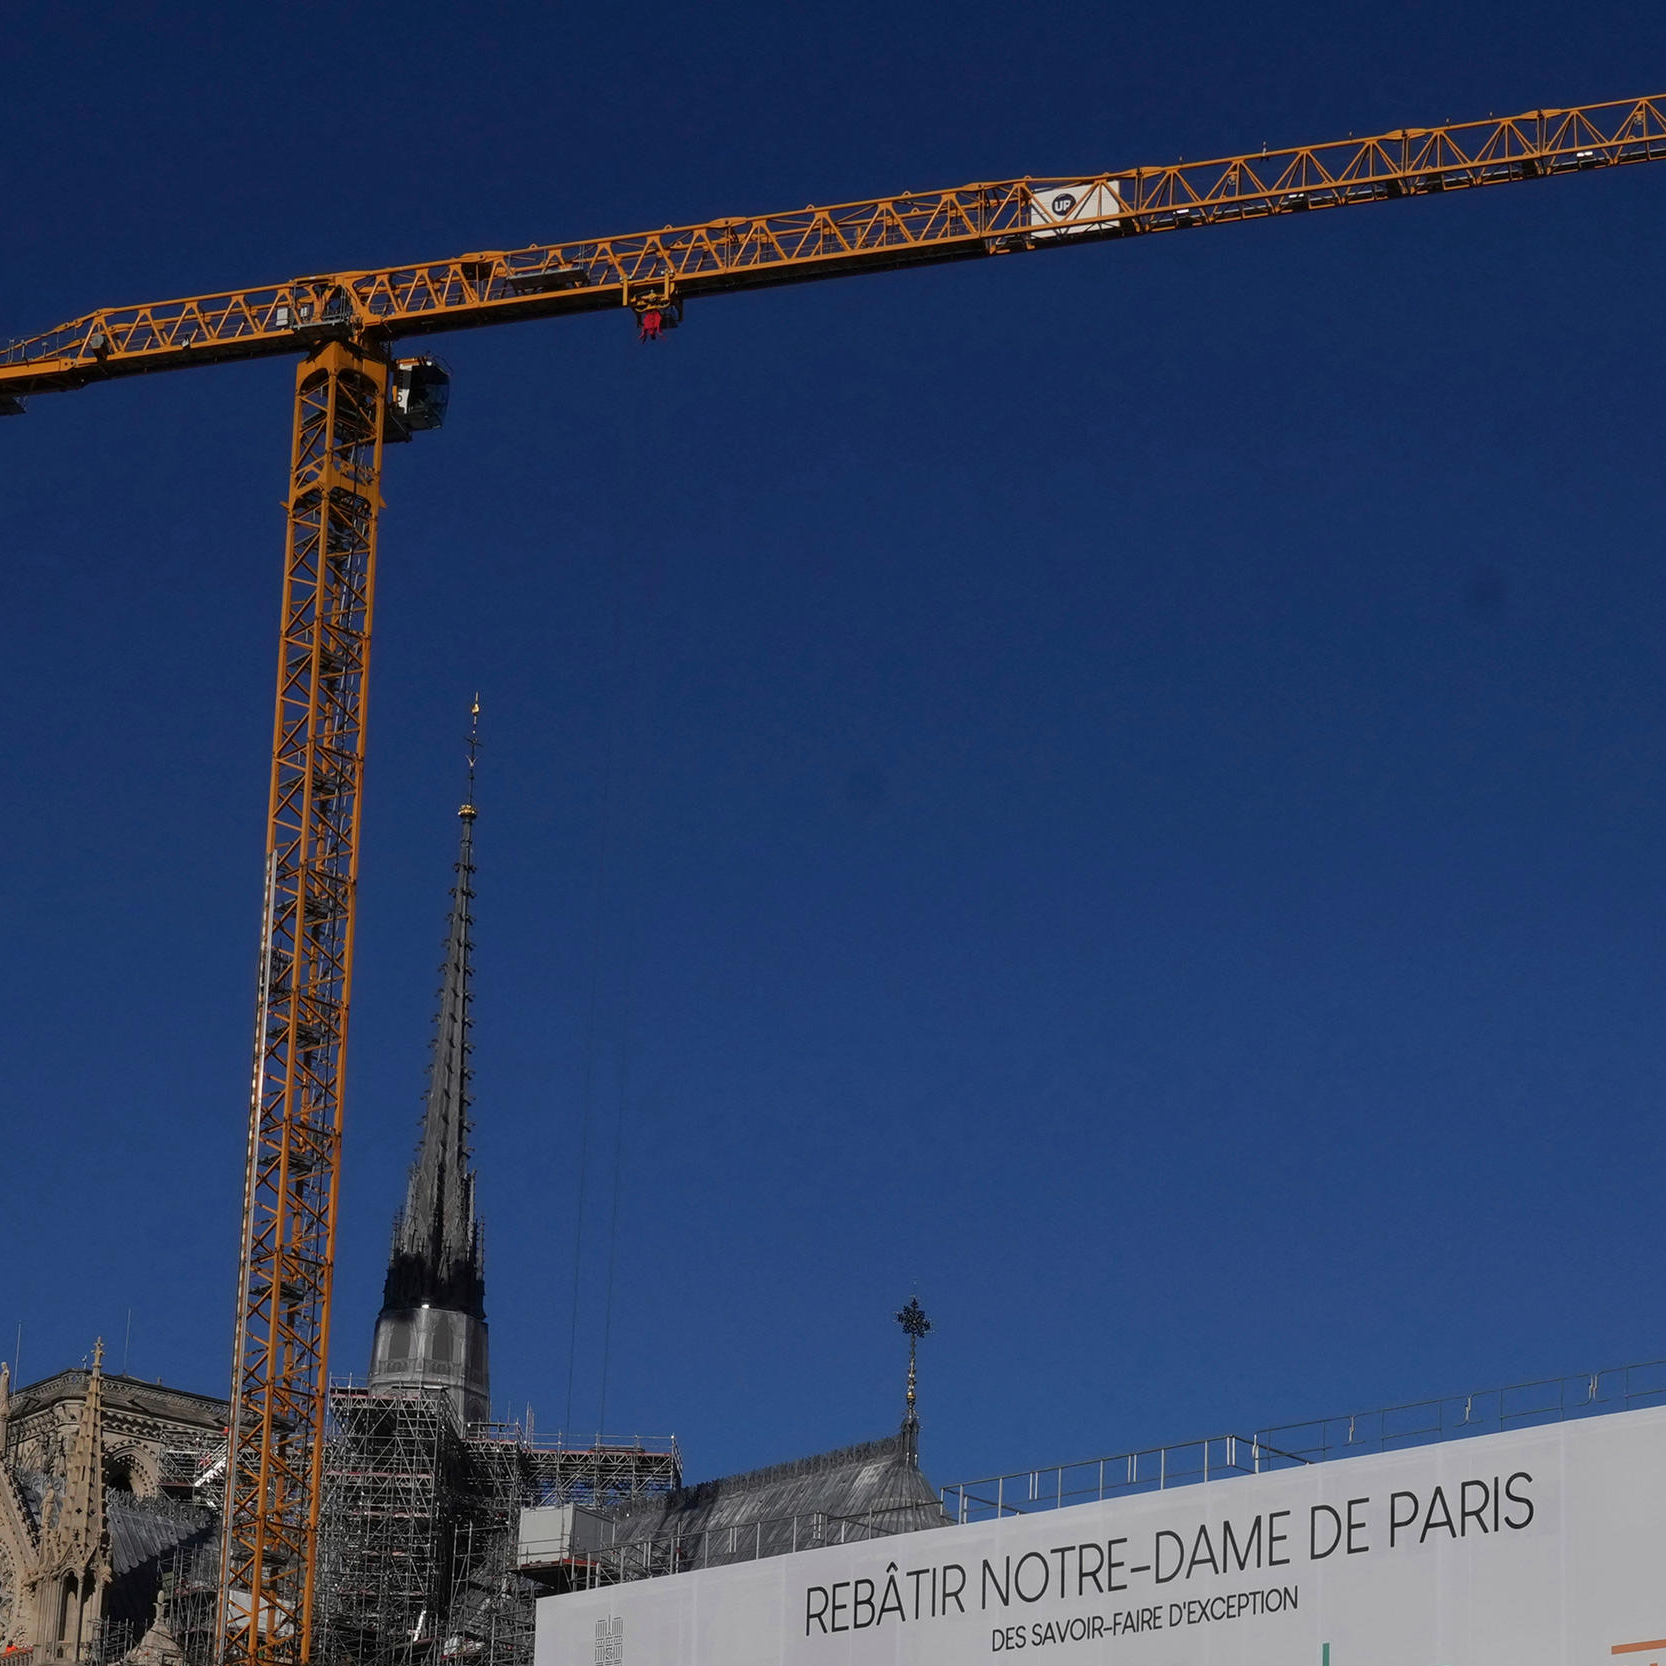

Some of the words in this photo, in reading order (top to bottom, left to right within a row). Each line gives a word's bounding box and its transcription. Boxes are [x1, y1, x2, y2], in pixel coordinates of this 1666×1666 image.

[805, 1562, 966, 1637] REBÂTIR
[981, 1510, 1291, 1610] NOTRE-DAME
[1309, 1497, 1370, 1561] DE
[1389, 1471, 1535, 1549] PARIS
[992, 1626, 1027, 1652] DES
[1031, 1605, 1163, 1647] SAVOIR-FAIRE
[1169, 1585, 1298, 1628] D'EXCEPTION
